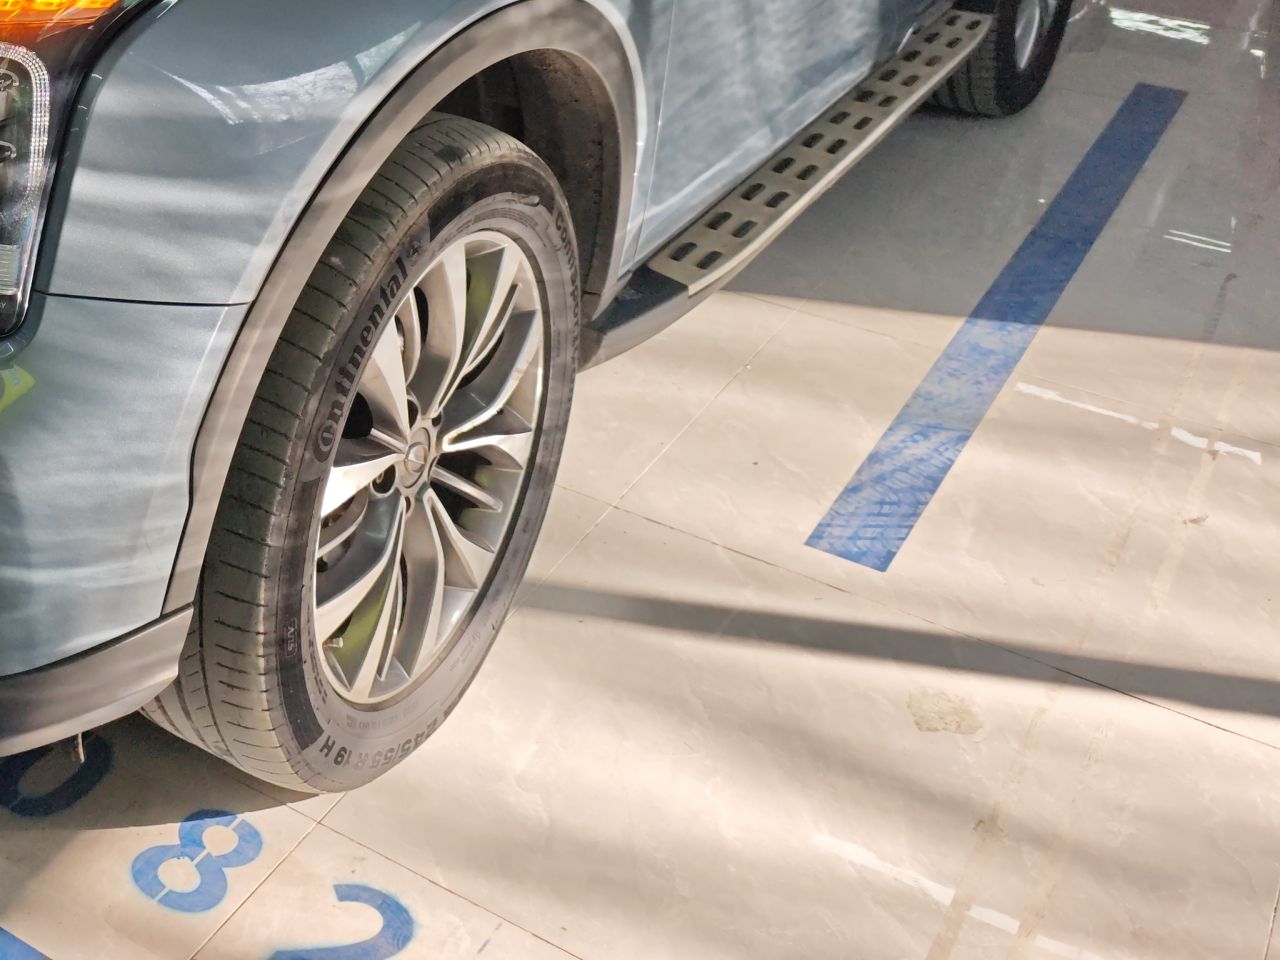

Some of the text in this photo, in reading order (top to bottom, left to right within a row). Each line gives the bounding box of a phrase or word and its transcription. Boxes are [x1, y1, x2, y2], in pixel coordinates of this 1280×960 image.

[313, 256, 409, 463] Continental
[319, 735, 336, 759] H
[333, 745, 352, 768] 19
